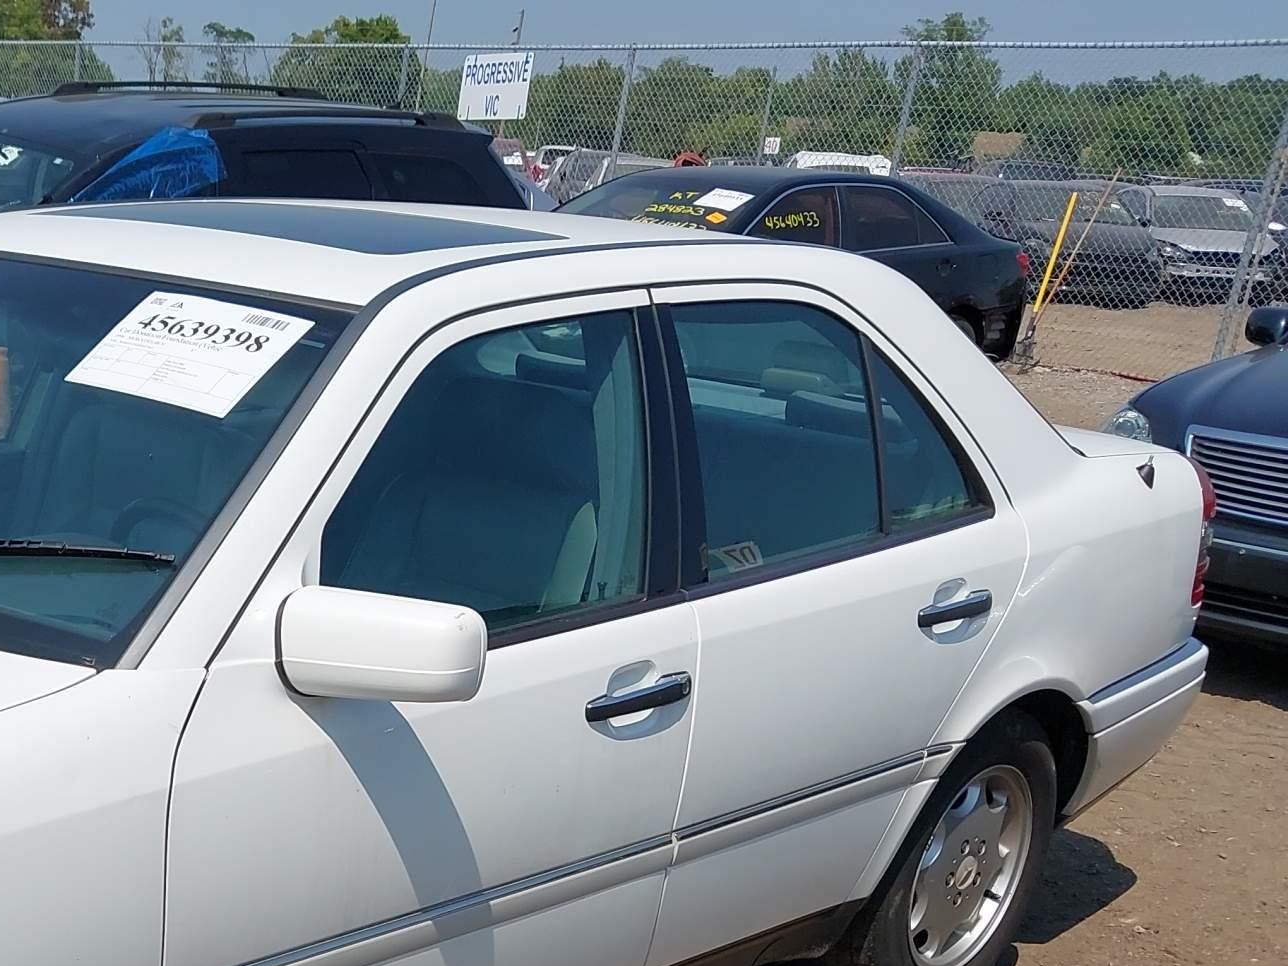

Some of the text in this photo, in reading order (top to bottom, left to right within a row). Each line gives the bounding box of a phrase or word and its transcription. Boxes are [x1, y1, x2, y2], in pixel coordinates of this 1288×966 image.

[465, 60, 529, 86] PROGRESSIVE
[485, 95, 500, 117] VIC
[765, 211, 820, 230] 45640433
[137, 313, 270, 353] 45639398
